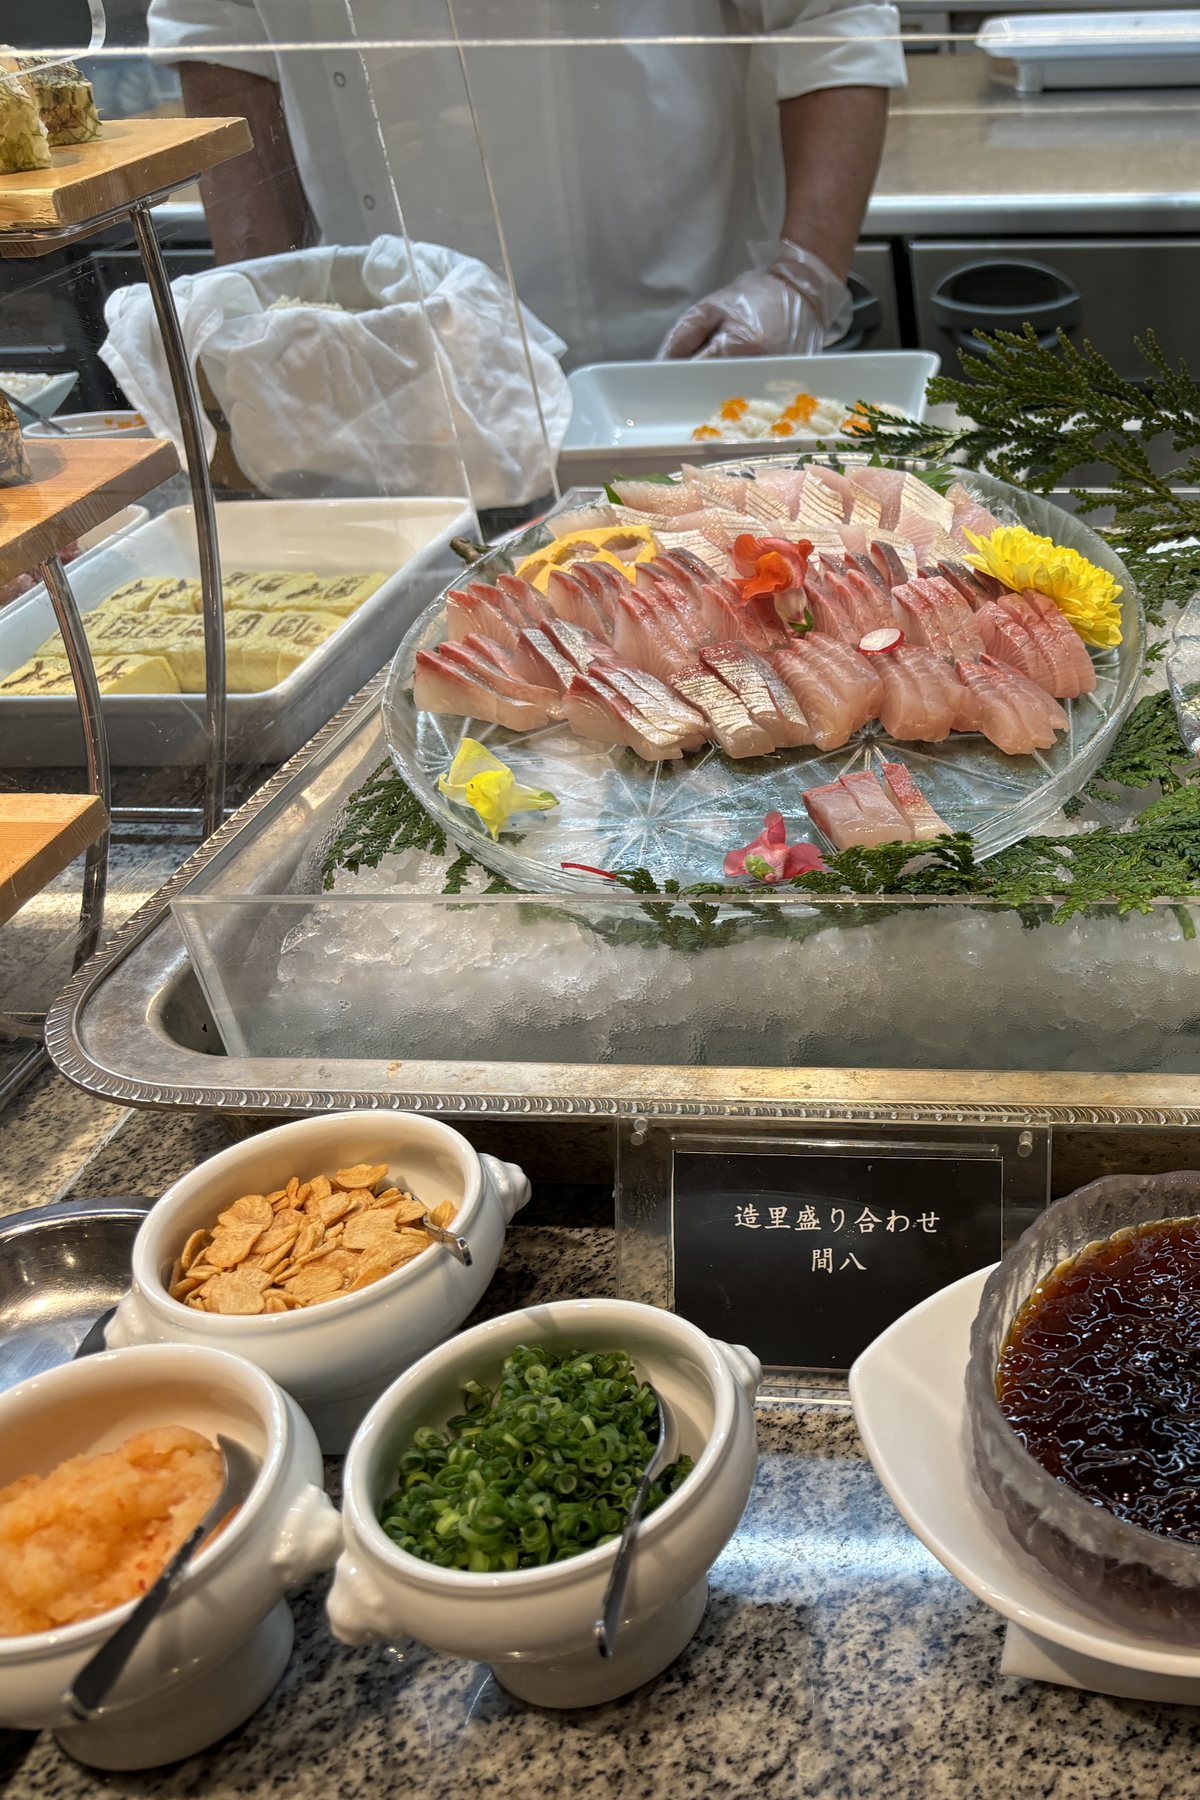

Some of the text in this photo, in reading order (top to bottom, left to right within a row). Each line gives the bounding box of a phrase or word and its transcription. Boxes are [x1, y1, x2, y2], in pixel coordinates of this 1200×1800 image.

[734, 1203, 940, 1234] 造里盛り合わせ
[811, 1247, 867, 1275] 間八
